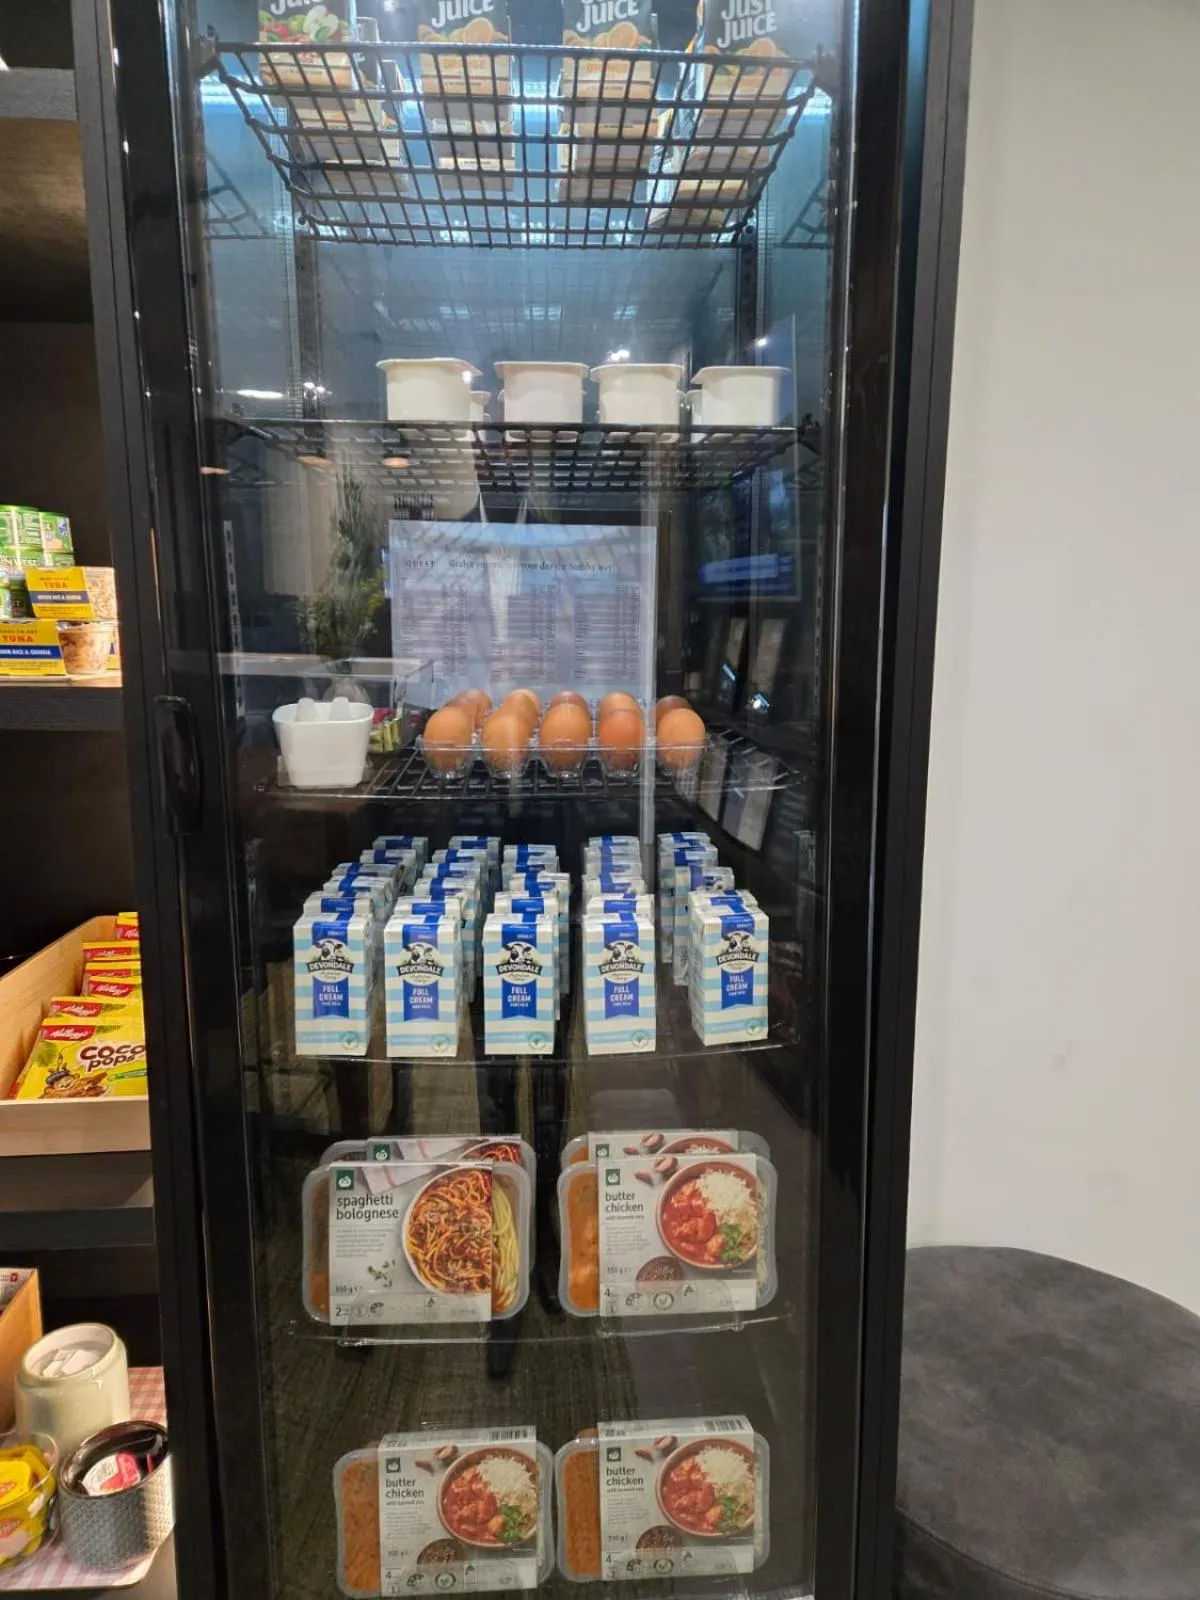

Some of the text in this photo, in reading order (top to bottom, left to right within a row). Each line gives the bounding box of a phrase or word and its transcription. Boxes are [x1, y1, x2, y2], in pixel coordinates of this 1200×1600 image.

[432, 0, 495, 28] JUICE
[721, 0, 772, 20] JUST
[576, 0, 640, 32] JUICE
[717, 11, 777, 48] JUICE
[718, 952, 756, 963] DEVONDALE
[310, 961, 351, 971] DEVONDALE
[400, 965, 441, 974] DEVONDALE
[499, 964, 540, 973] DEVONDALE
[601, 962, 642, 972] DEVONDALE
[728, 975, 744, 983] FULL
[322, 985, 339, 993] FULL
[412, 988, 429, 996] FULL
[511, 986, 528, 994] FULL
[613, 985, 630, 993] FULL
[726, 983, 749, 991] CREAM
[319, 993, 343, 1001] CREAM
[409, 996, 433, 1004] CREAM
[507, 995, 531, 1003] CREAM
[610, 994, 634, 1002] CREAM
[80, 1044, 145, 1060] COCO
[87, 1054, 136, 1072] pops
[336, 1193, 393, 1209] spaghetti
[605, 1191, 636, 1201] butter
[605, 1202, 644, 1213] chicken
[336, 1208, 399, 1222] bolognese
[336, 1306, 342, 1316] 2
[606, 1466, 636, 1476] butter
[385, 1478, 416, 1487] butter
[606, 1476, 643, 1486] chicken
[385, 1489, 425, 1498] chicken
